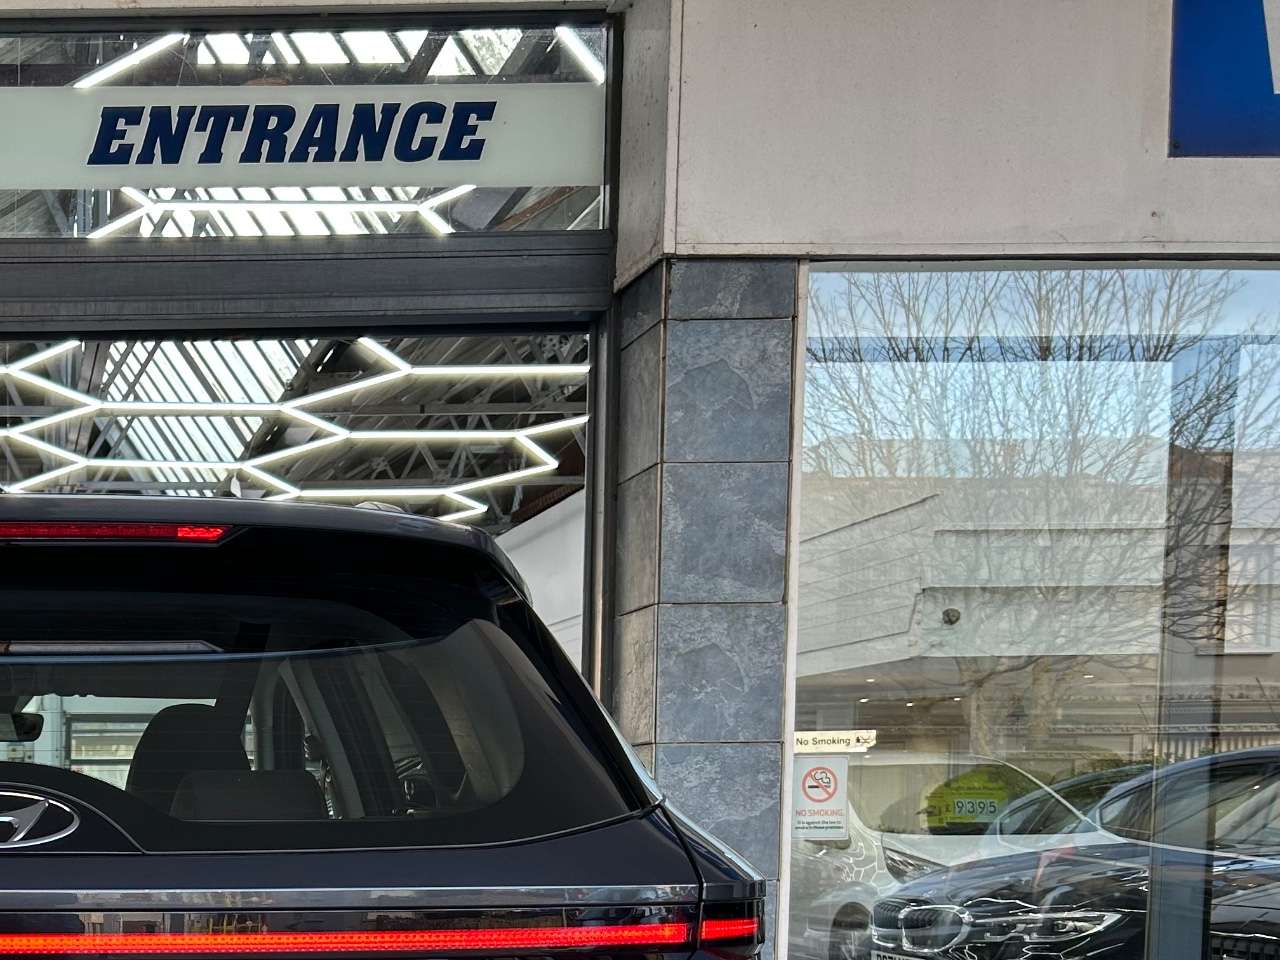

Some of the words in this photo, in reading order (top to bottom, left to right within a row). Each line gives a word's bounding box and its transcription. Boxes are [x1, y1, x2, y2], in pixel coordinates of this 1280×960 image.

[86, 101, 498, 166] ENTRANCE
[795, 738, 809, 746] No
[812, 737, 851, 747] Smoking
